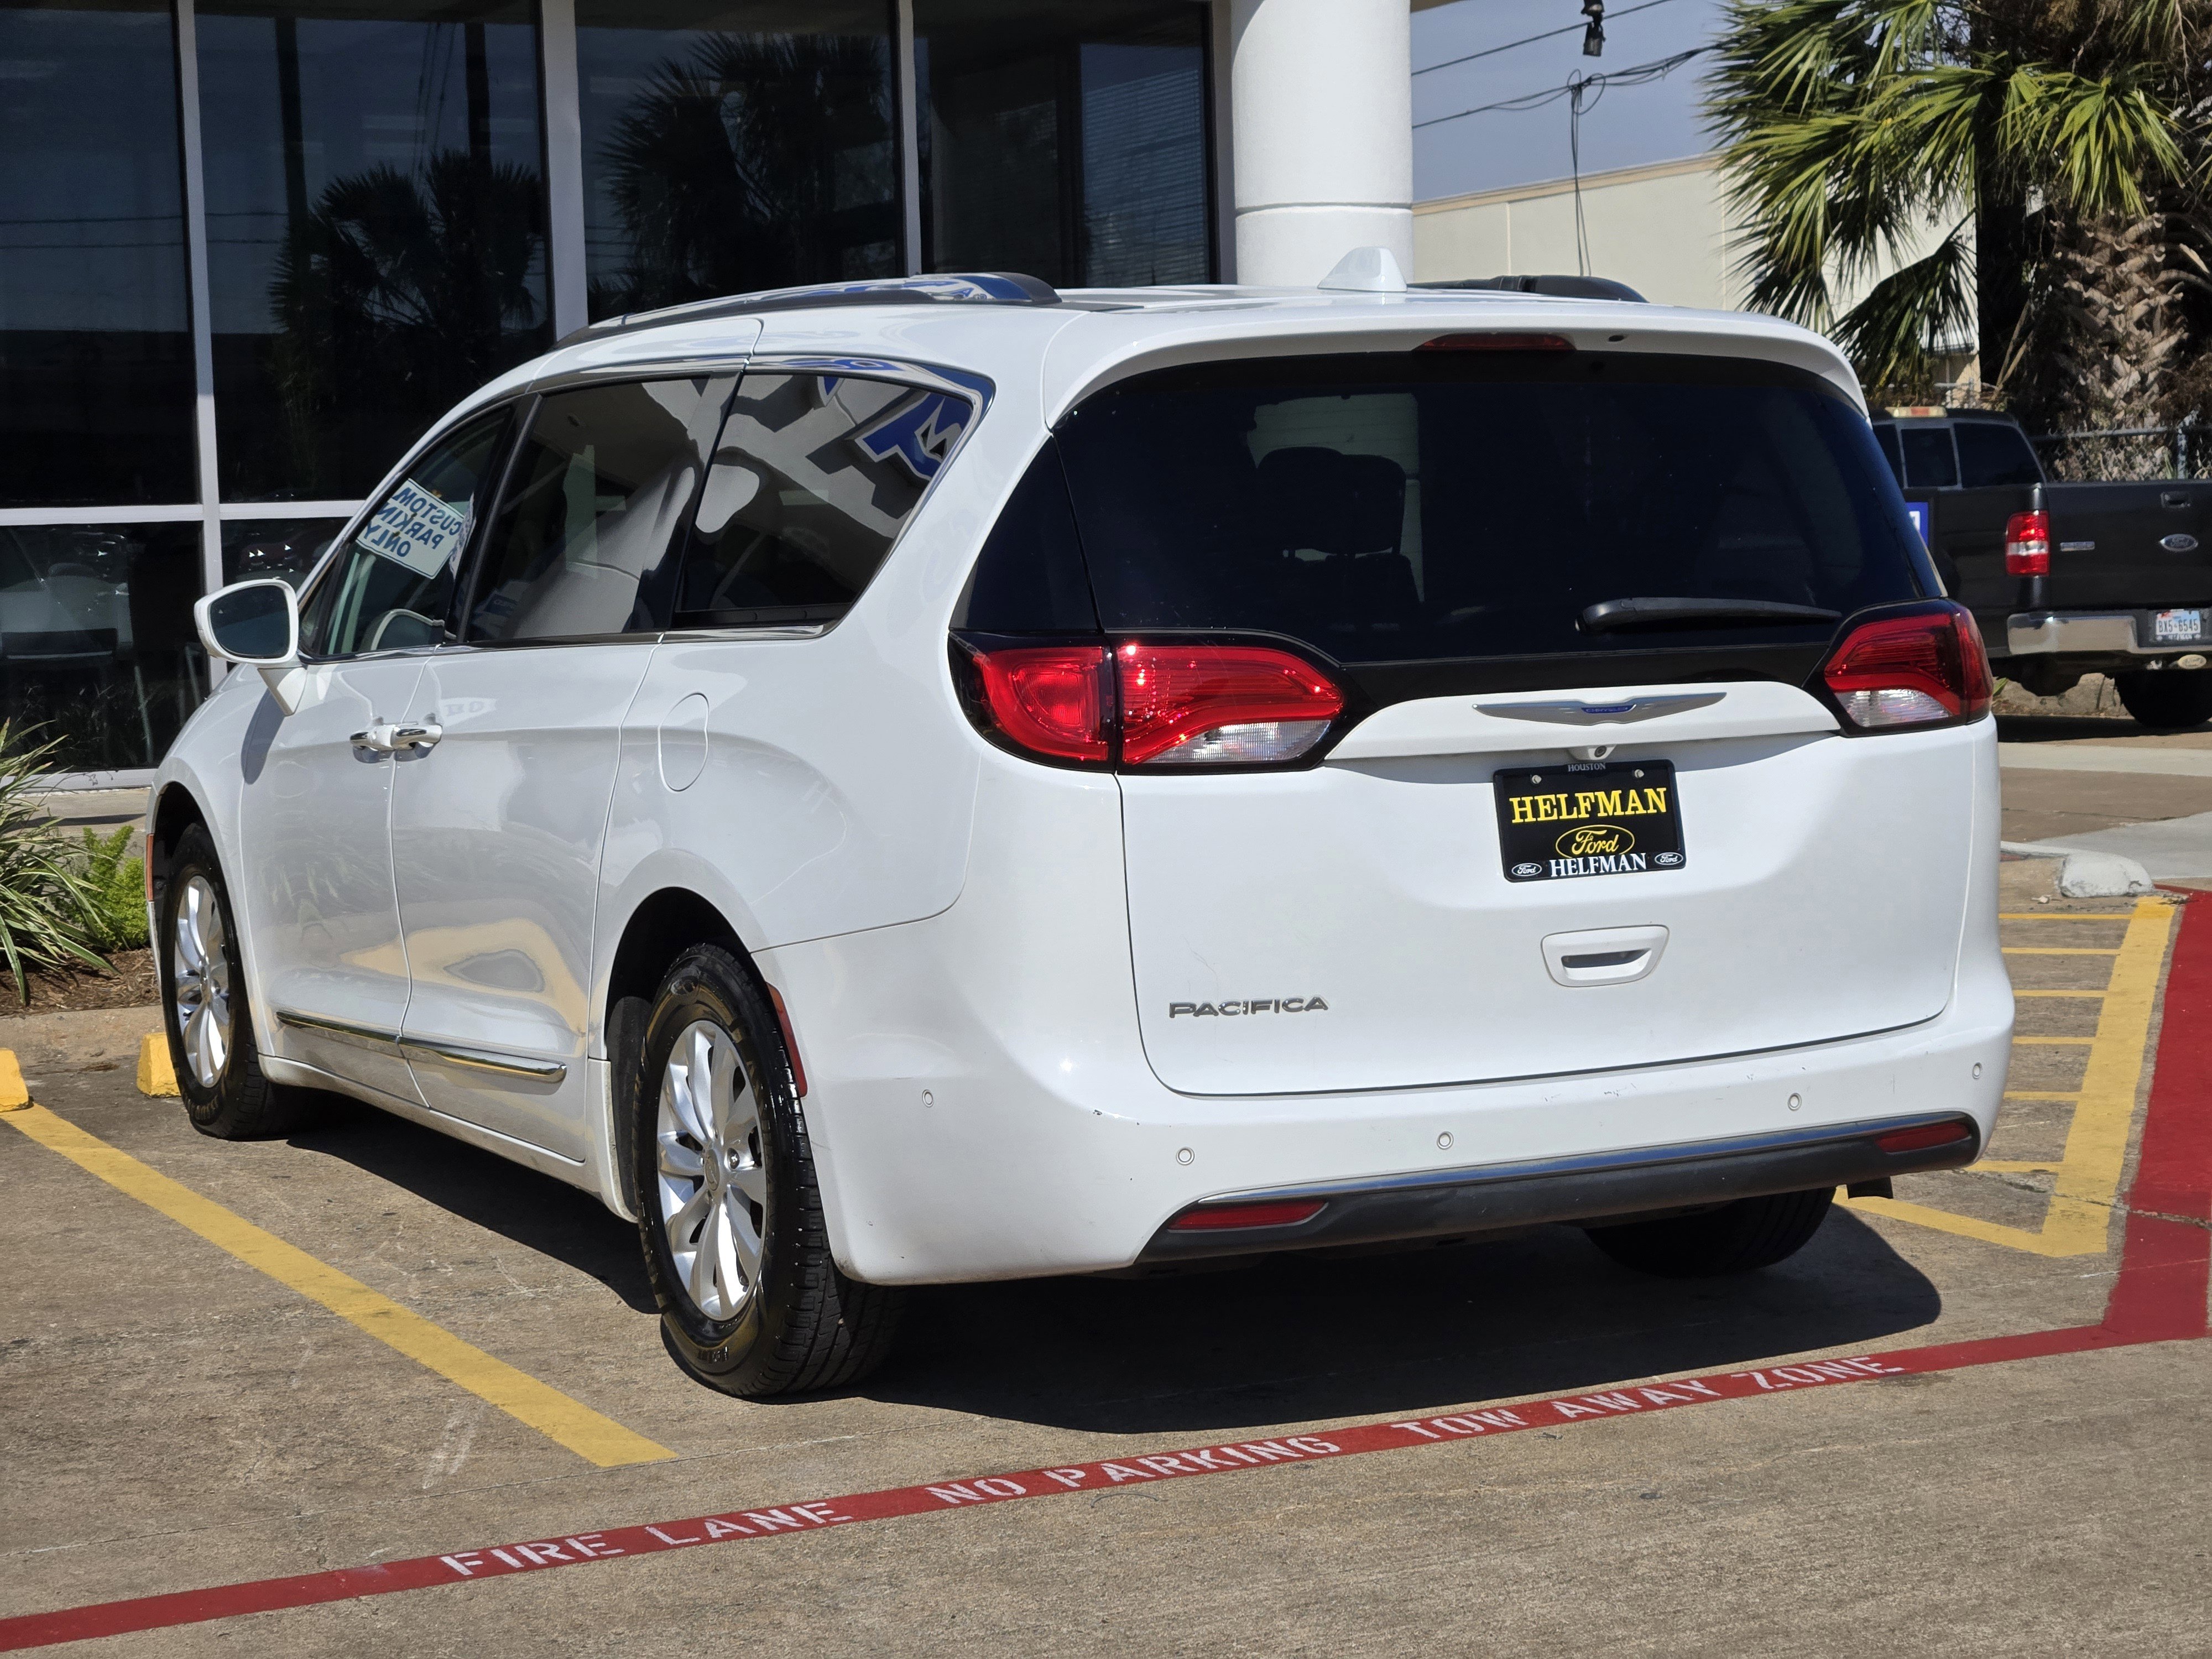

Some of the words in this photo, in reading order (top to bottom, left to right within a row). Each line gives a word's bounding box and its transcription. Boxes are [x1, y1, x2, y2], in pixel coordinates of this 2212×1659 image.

[1568, 762, 1606, 772] HOUSTON
[1509, 787, 1667, 823] HELFMAN
[1572, 829, 1620, 855] Ford
[1549, 853, 1646, 877] HELFMAN
[1169, 997, 1329, 1019] PACIFICA
[441, 1533, 625, 1576] FIRE
[644, 1502, 853, 1546] LANE
[925, 1478, 1026, 1504] NO
[1043, 1437, 1340, 1488] PARKING
[1390, 1408, 1529, 1440] TOW
[1550, 1379, 1722, 1420] AWAY
[1731, 1357, 1906, 1390] ZONE
